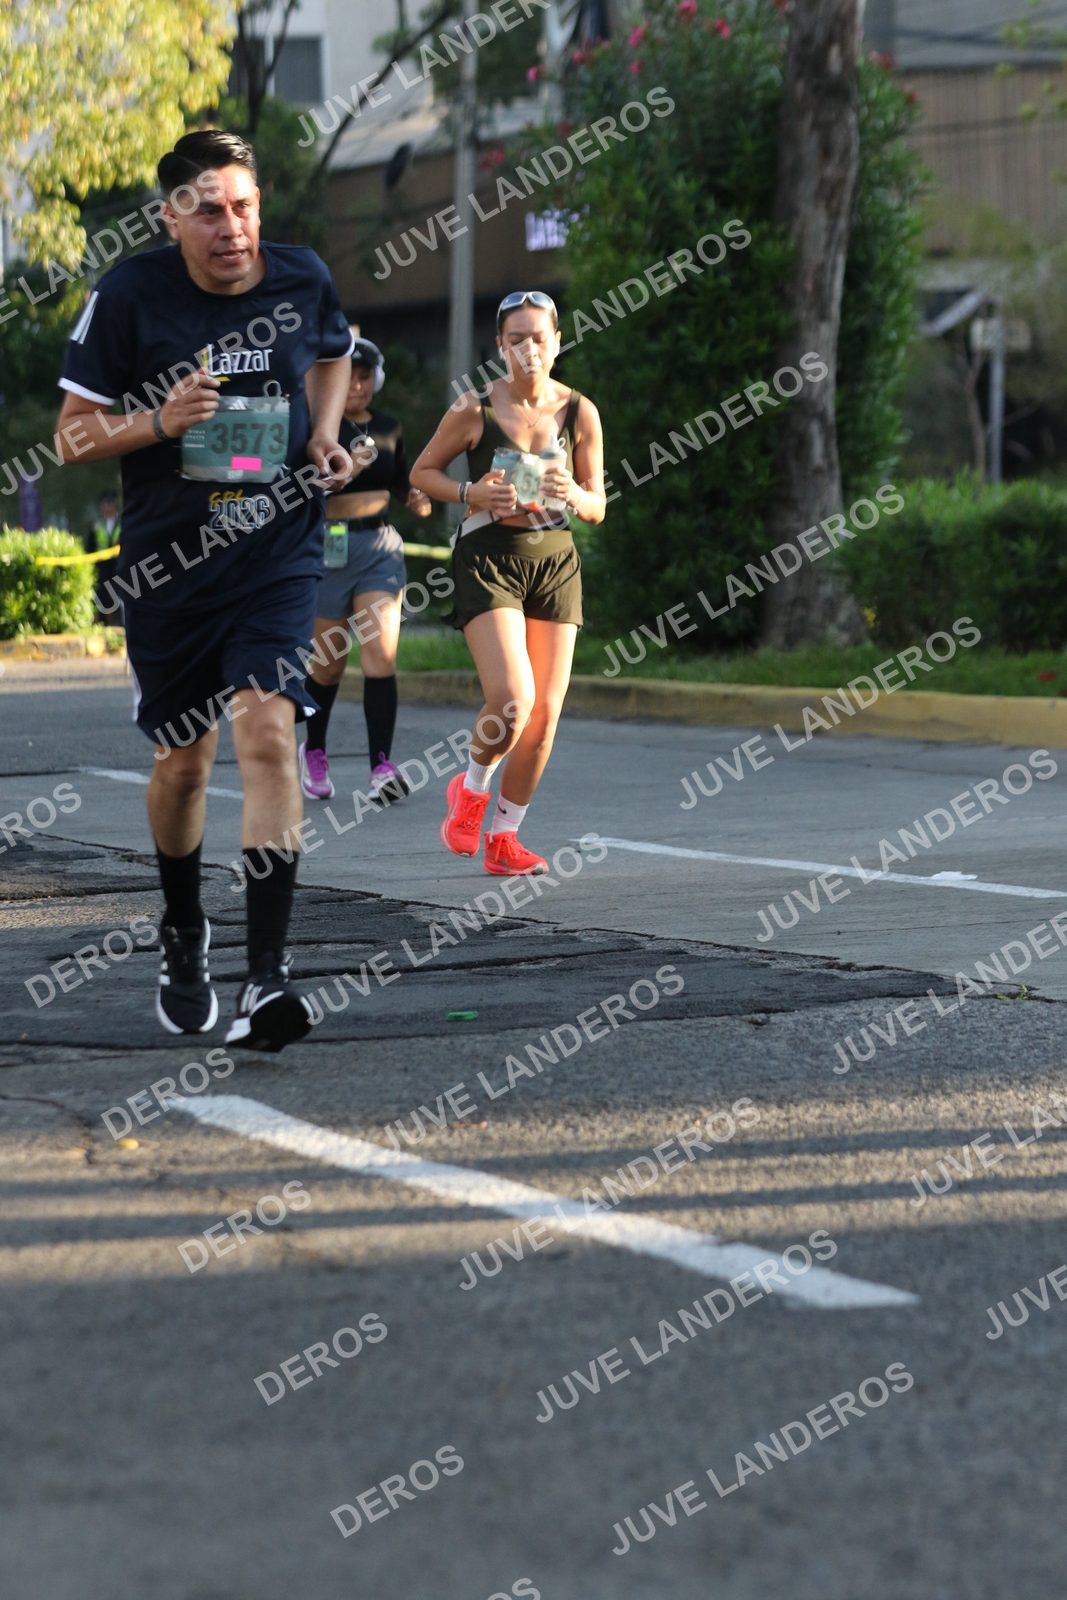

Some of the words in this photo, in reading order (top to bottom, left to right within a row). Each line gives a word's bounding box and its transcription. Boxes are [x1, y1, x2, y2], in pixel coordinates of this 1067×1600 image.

[207, 344, 273, 375] Lazzar
[210, 422, 285, 454] 3573
[209, 495, 270, 531] 2026
